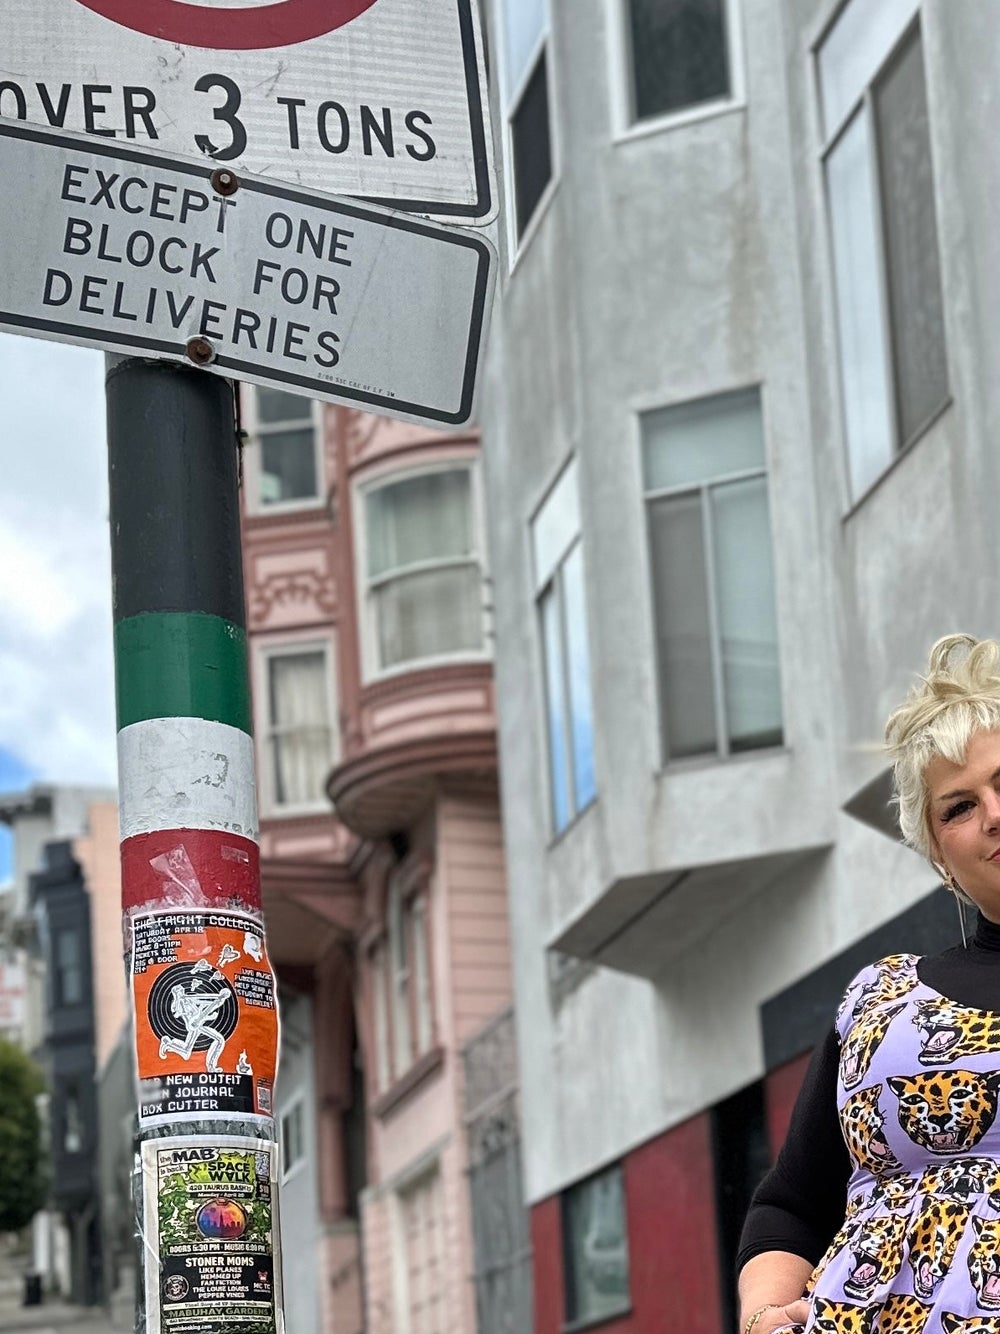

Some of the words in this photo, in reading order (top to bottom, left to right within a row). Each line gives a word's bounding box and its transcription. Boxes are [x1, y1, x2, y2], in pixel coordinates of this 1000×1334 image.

[0, 81, 158, 139] OVER
[194, 73, 247, 161] 3
[277, 97, 437, 161] TONS
[60, 163, 237, 233] EXCEPT
[265, 212, 355, 267] ONE
[63, 217, 221, 283] BLOCK
[252, 258, 341, 315] FOR
[42, 268, 341, 368] DELIVERIES
[157, 955, 178, 963] DOOR
[166, 1075, 192, 1085] NEW
[199, 1074, 242, 1085] OUTFIT
[175, 1086, 235, 1098] JOURNAL
[142, 1103, 163, 1116] BOX
[168, 1099, 219, 1111] CUTTER
[172, 1149, 215, 1163] MAB
[208, 1162, 249, 1172] SPACE
[208, 1171, 250, 1182] WALK
[185, 1257, 224, 1268] STONER
[226, 1256, 254, 1267] MOMS
[168, 1307, 223, 1317] MABUHAY
[225, 1307, 268, 1316] GARDENS
